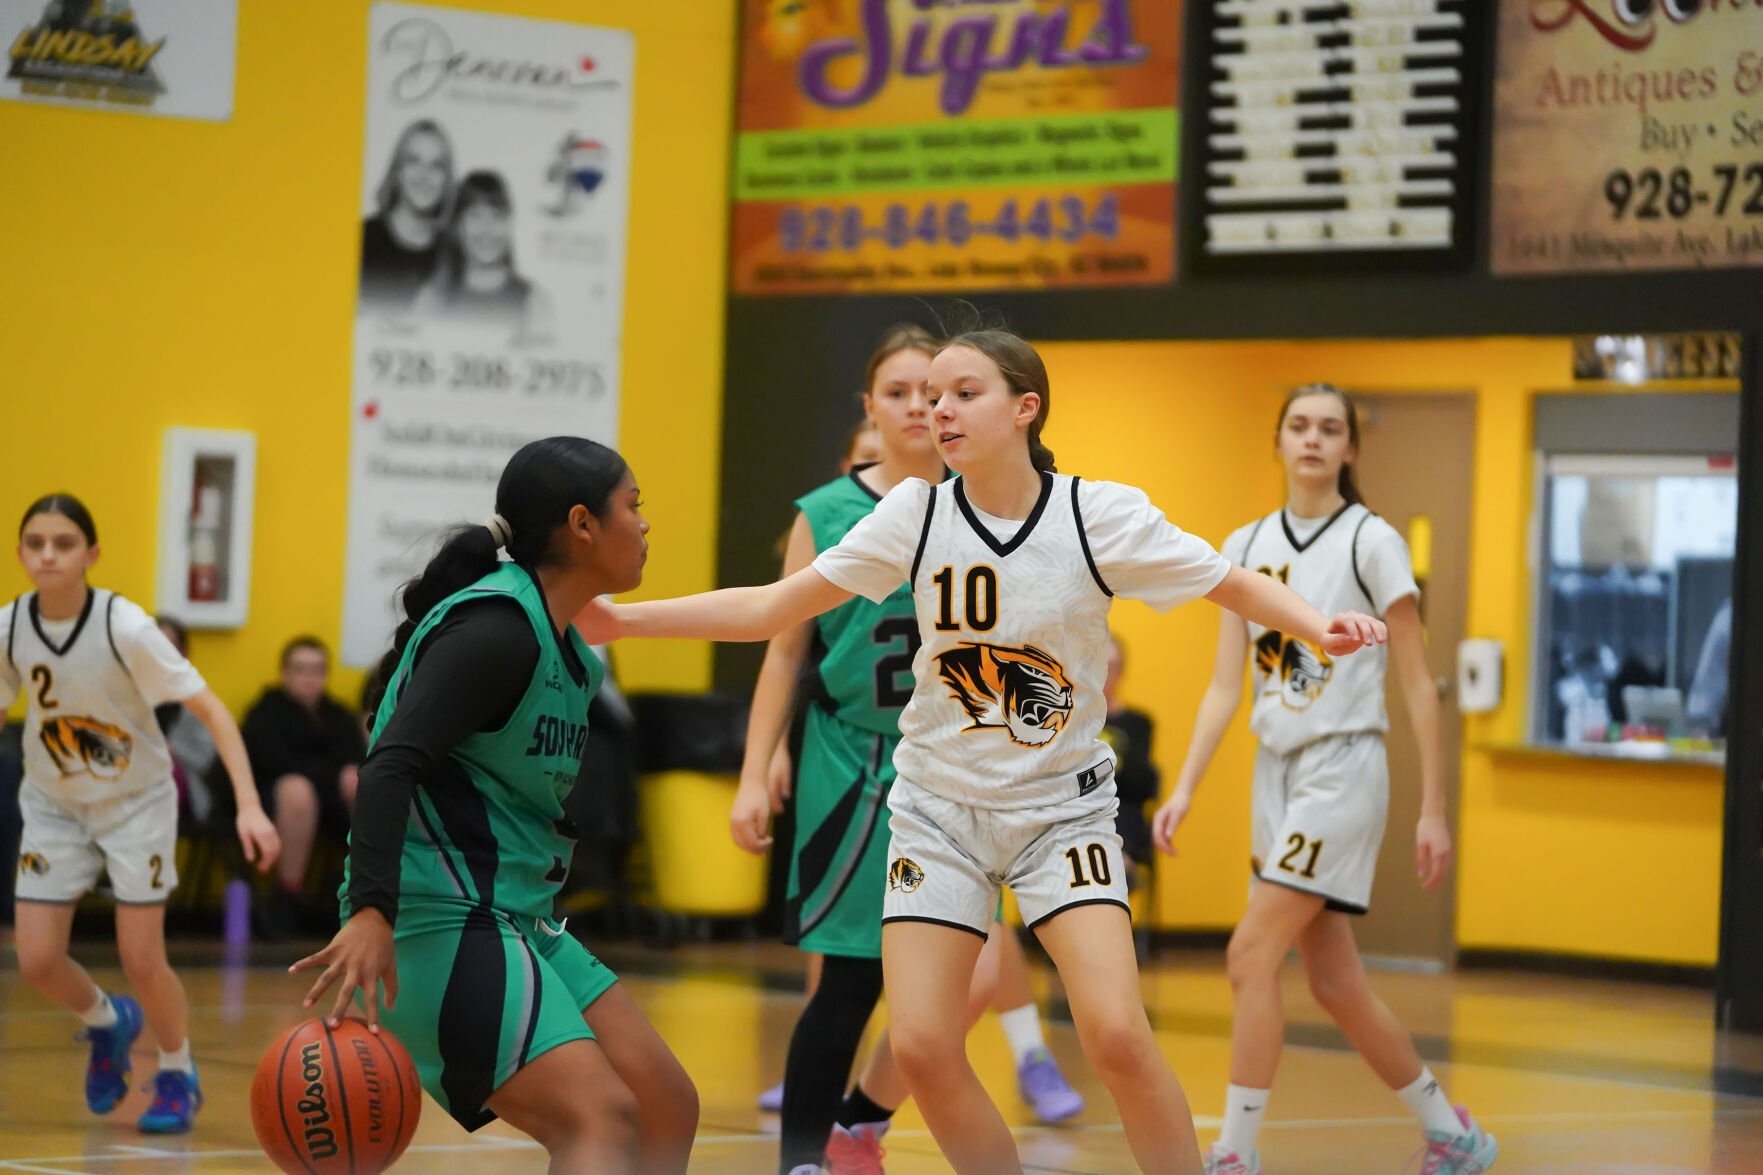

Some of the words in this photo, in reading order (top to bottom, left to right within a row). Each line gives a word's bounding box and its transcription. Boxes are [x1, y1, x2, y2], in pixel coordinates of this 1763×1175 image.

[8, 27, 167, 73] LINDSAY
[1535, 60, 1716, 114] Antiques
[1640, 114, 1698, 154] Buy
[1604, 162, 1763, 221] 928-72
[933, 565, 998, 633] 10
[31, 663, 58, 710] 2
[149, 854, 163, 889] 2
[1066, 843, 1112, 889] 10
[1277, 831, 1324, 879] 21
[297, 1040, 339, 1162] Wilson
